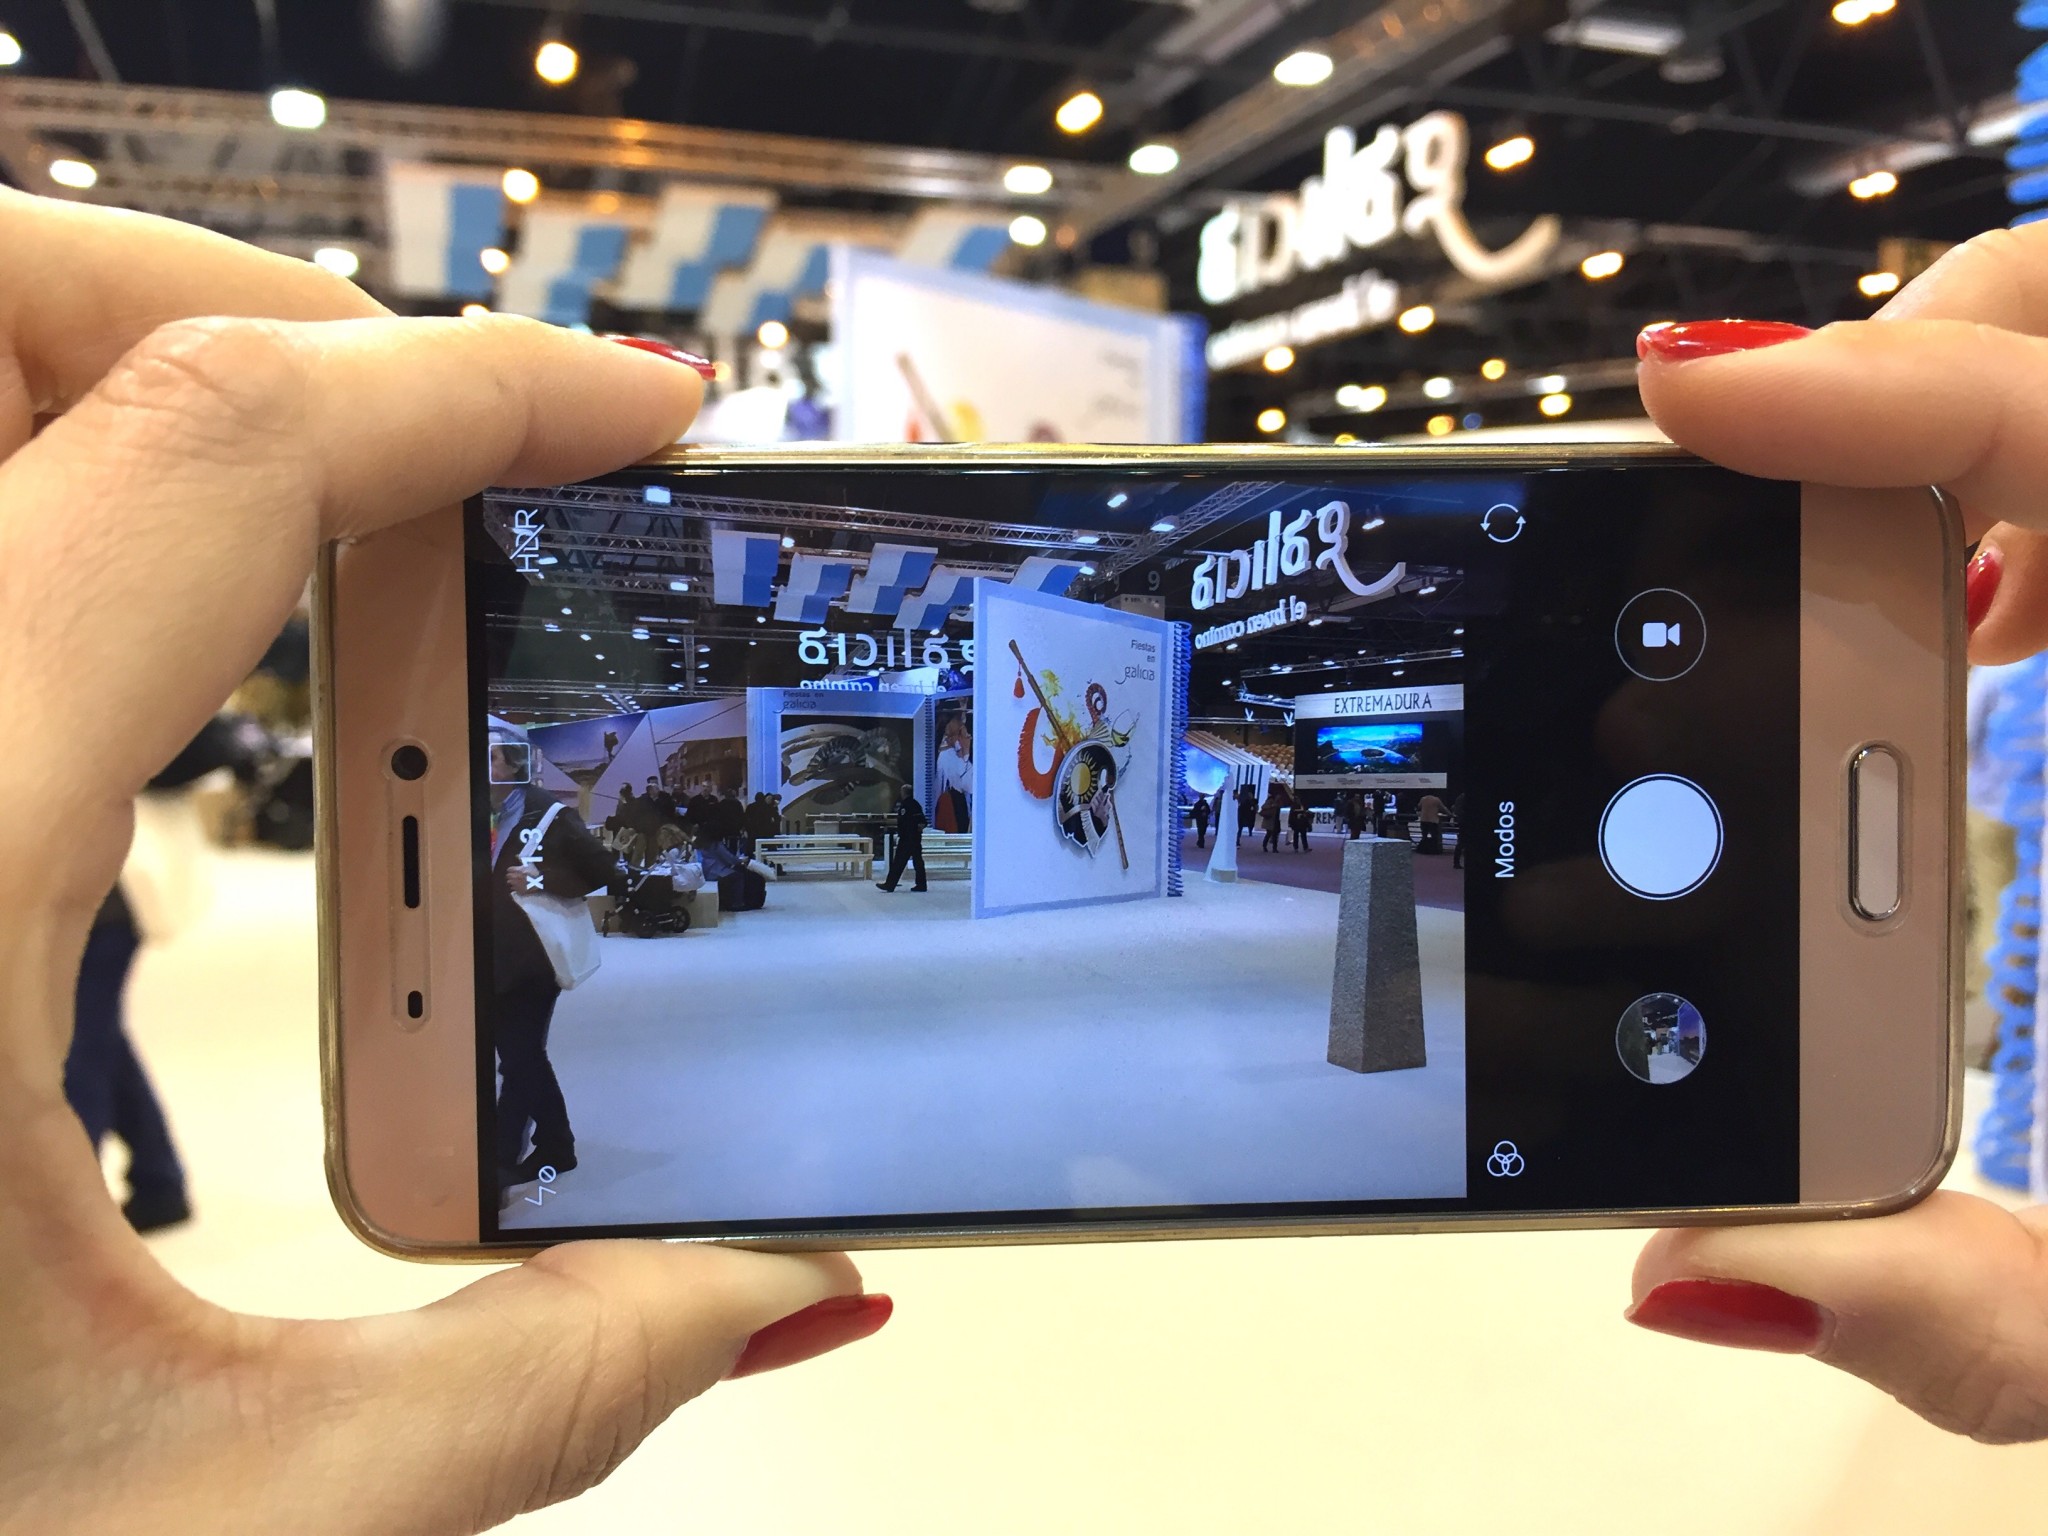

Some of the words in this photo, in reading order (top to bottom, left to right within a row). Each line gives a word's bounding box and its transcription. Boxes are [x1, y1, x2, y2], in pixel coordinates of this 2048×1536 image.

[514, 508, 540, 573] HDR
[1131, 639, 1156, 653] Fiestas
[1146, 654, 1156, 663] en
[1114, 664, 1155, 685] galicia
[772, 698, 817, 714] galicia
[1333, 692, 1433, 714] EXTREMADURA
[1493, 801, 1515, 878] Modos
